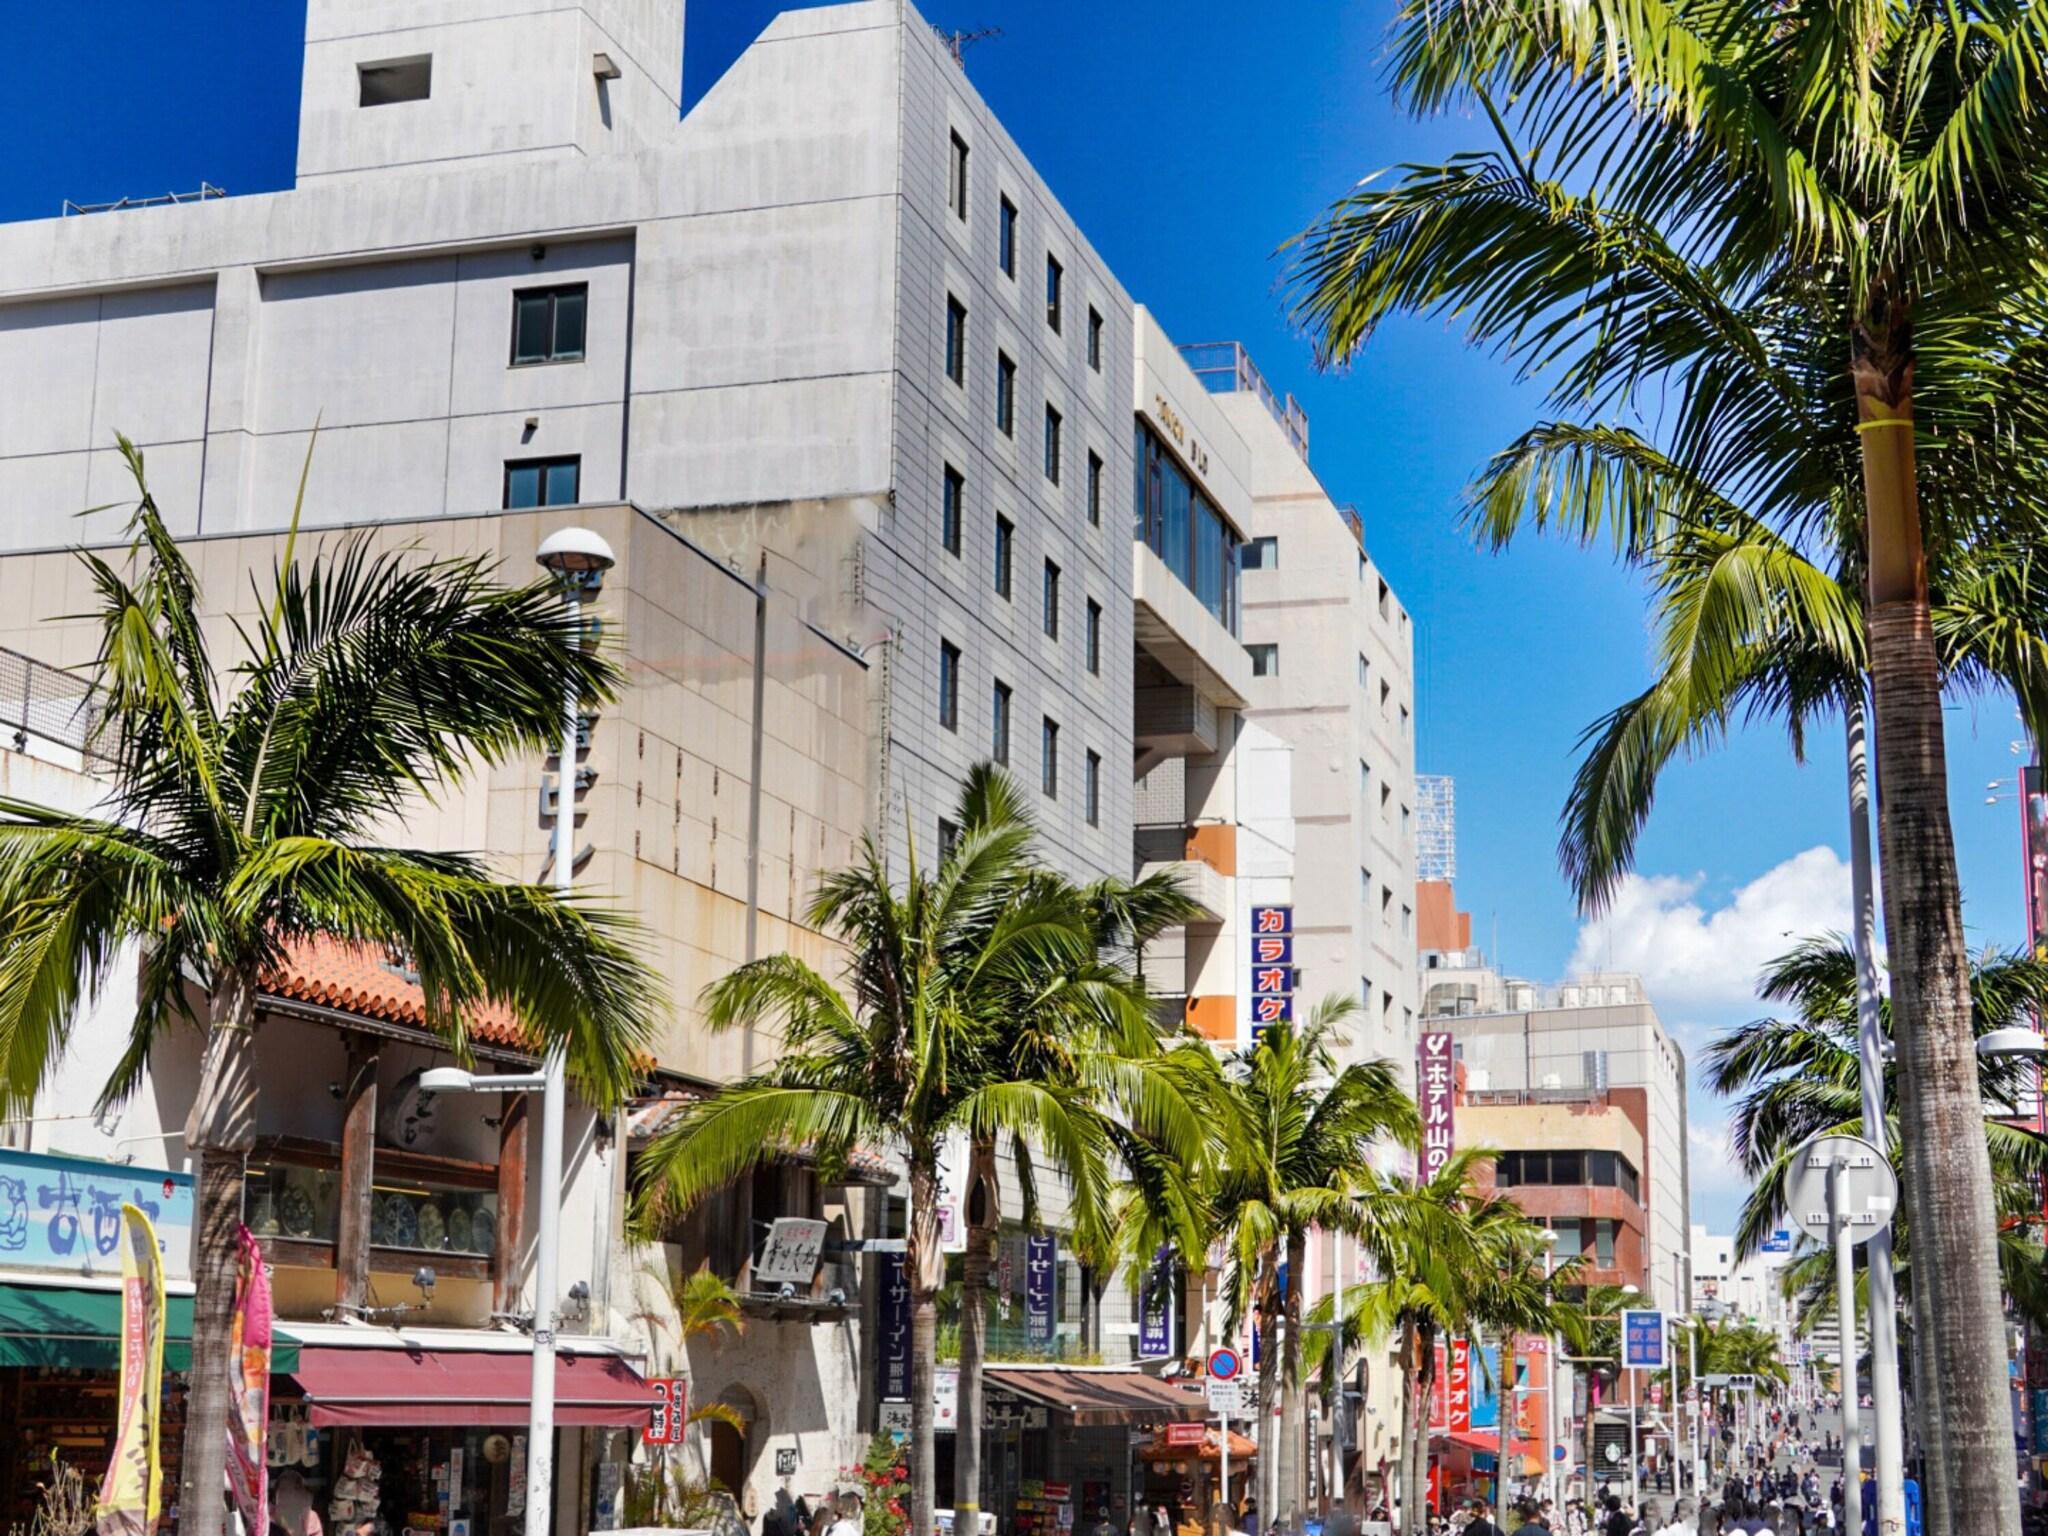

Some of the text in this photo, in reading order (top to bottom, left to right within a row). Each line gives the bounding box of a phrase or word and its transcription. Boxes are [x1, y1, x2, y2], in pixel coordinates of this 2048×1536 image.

[1258, 909, 1285, 1022] カラオケ
[1451, 1348, 1468, 1426] カラオケ
